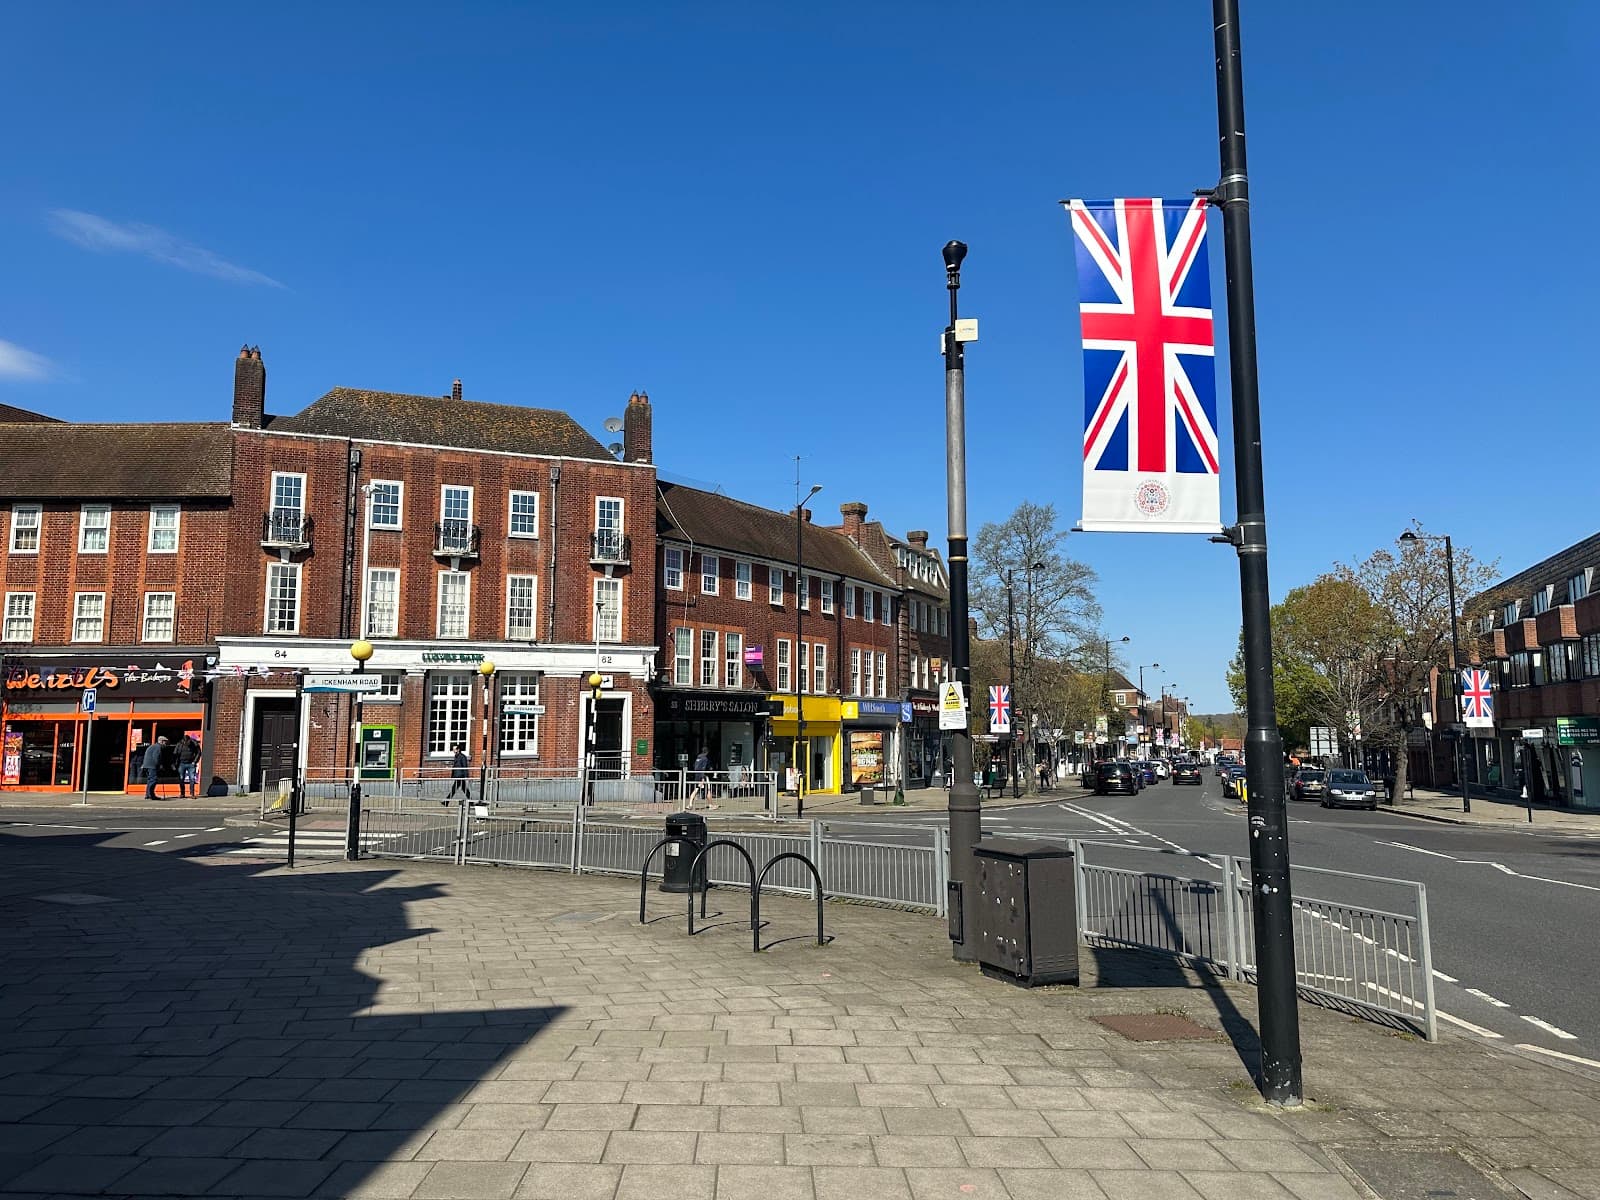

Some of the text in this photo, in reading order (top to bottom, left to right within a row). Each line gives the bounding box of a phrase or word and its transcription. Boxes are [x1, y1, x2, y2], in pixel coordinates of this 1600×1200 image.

[274, 649, 287, 658] 84
[601, 655, 612, 664] 82
[6, 667, 118, 688] Wenzel's
[685, 700, 758, 712] SHERRY'S SALON
